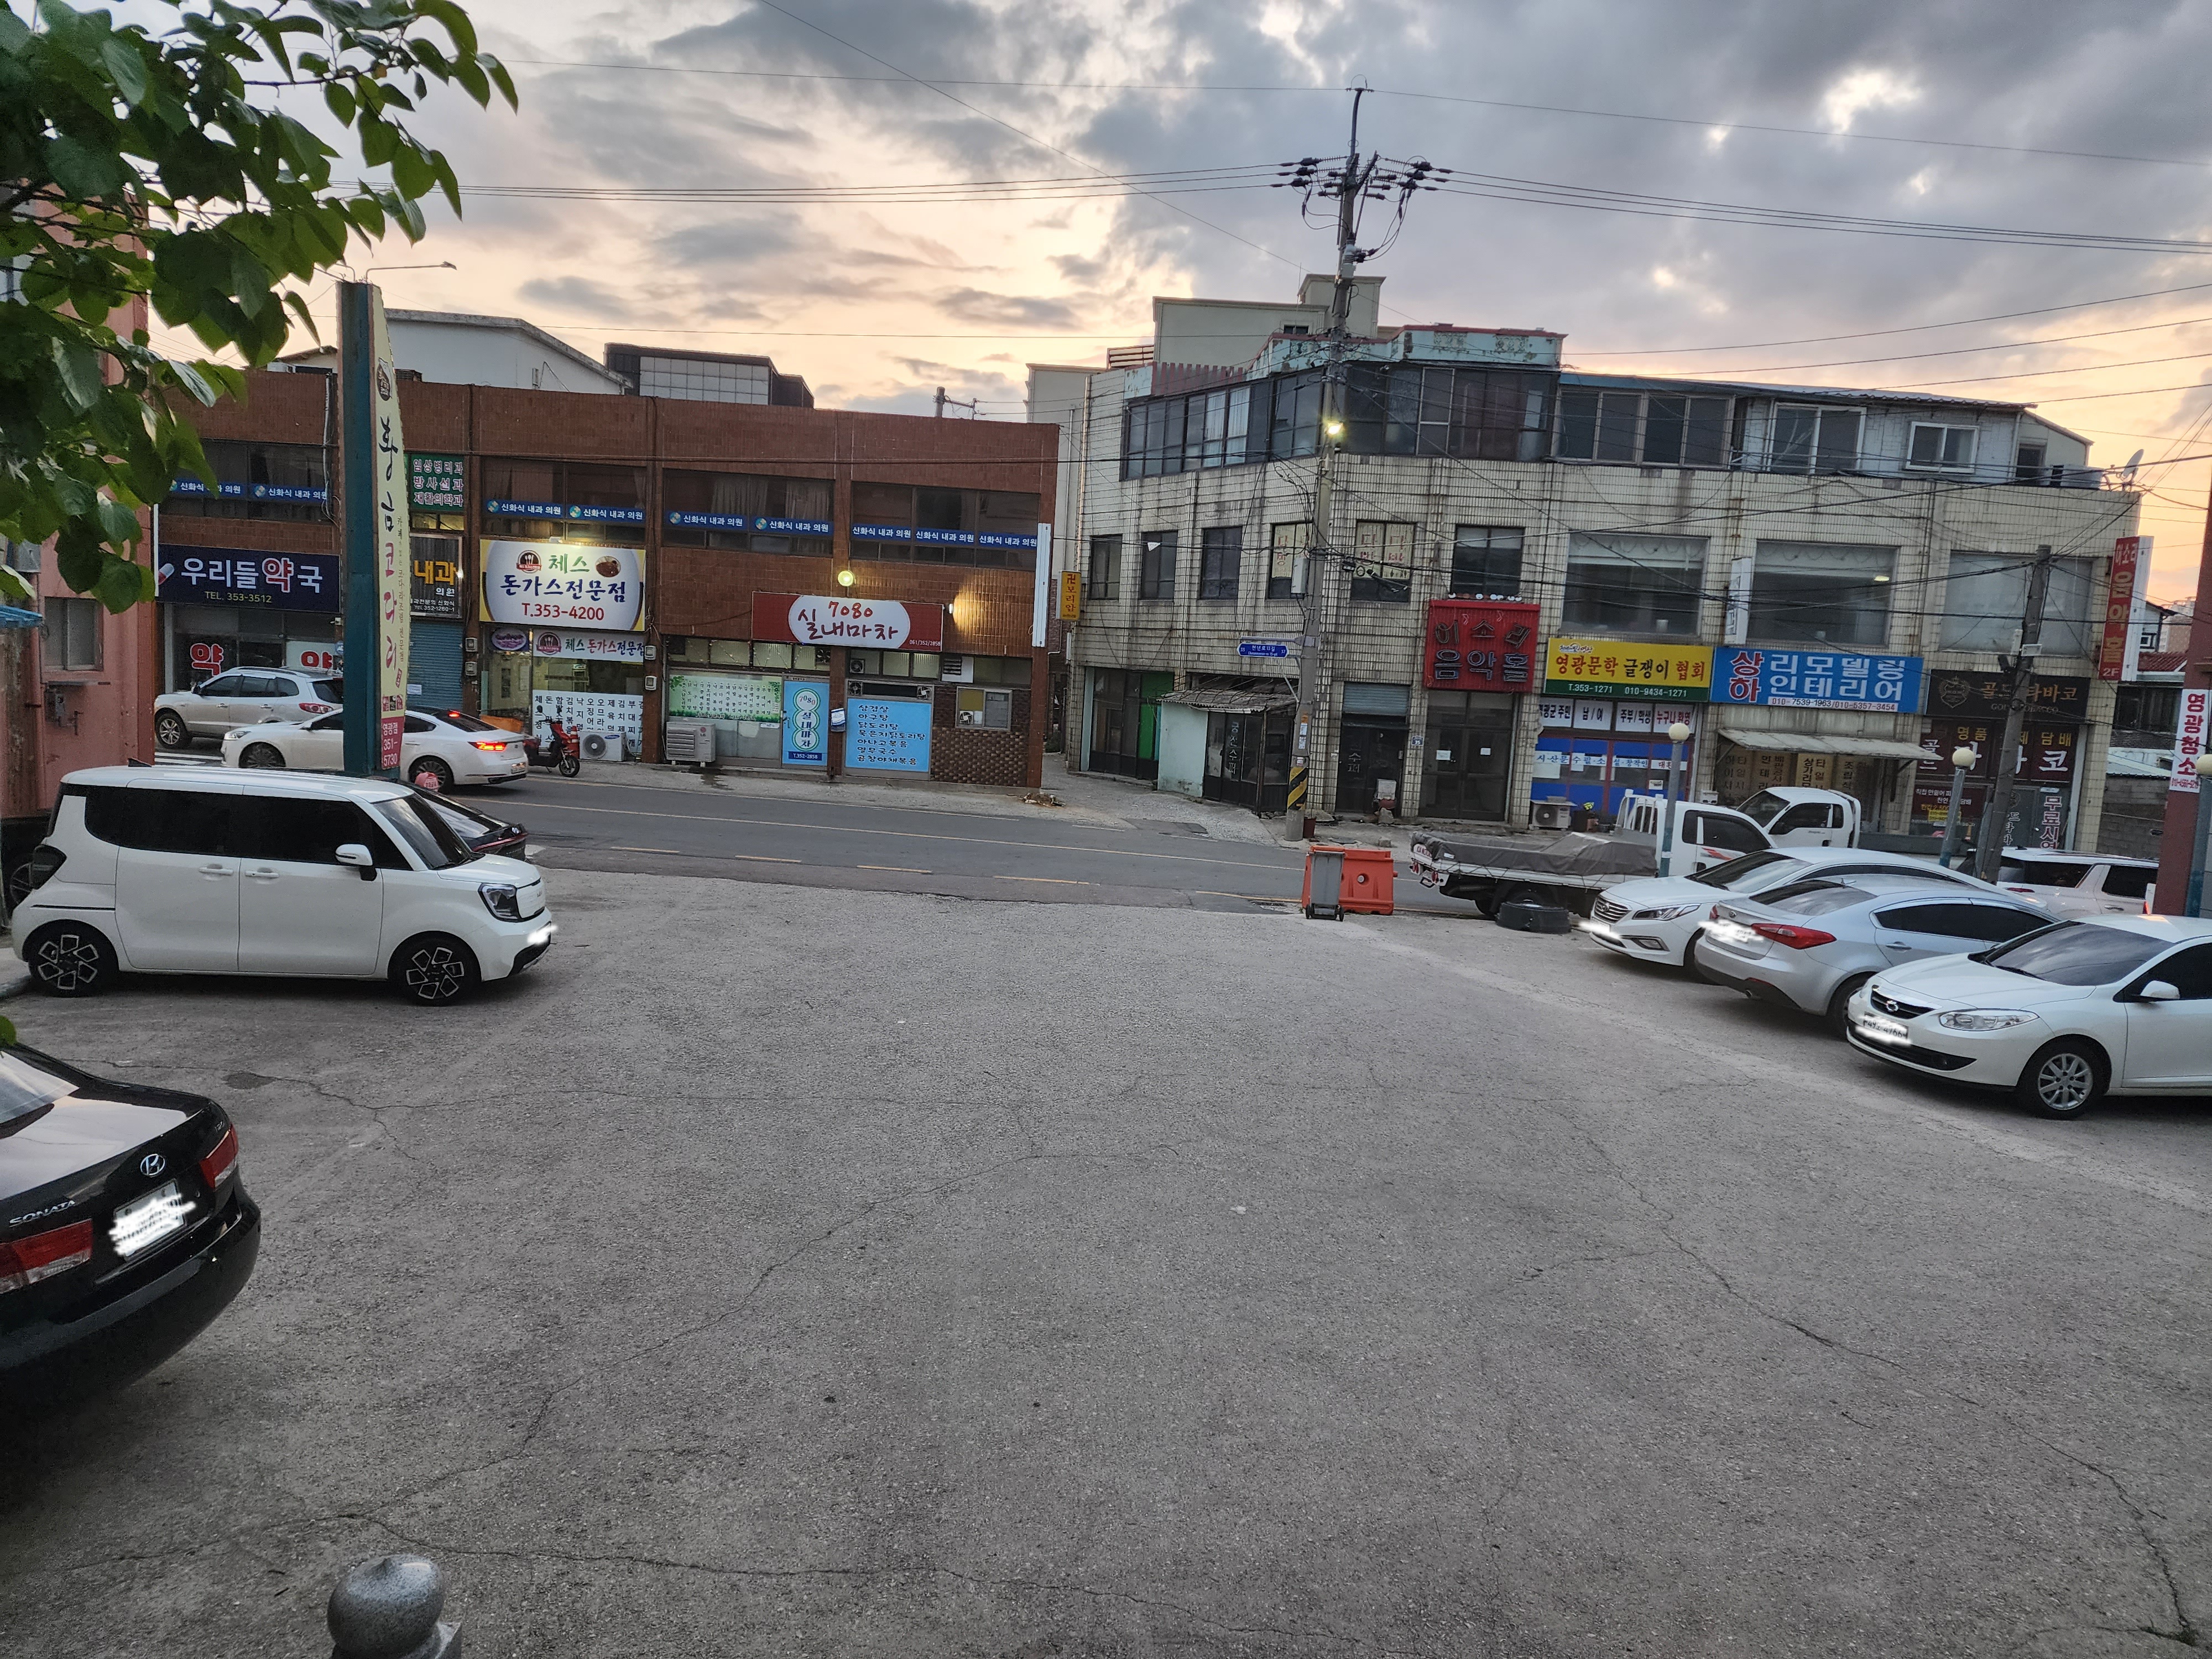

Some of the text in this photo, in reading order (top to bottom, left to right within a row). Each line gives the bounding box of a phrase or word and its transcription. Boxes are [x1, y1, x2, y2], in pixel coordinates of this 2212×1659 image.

[414, 459, 463, 475] 임상병리과
[180, 482, 204, 491] 신화식
[225, 486, 241, 494] 의원
[414, 476, 463, 492] 방사선과
[268, 488, 291, 497] 신화식
[295, 490, 310, 498] 내과
[414, 492, 463, 507] 재활의학과
[501, 503, 561, 515] 신화식 내과 의원
[583, 508, 643, 520] 신화식 내과 의원
[683, 515, 743, 526] 신화식 내과 의원
[769, 520, 828, 533] 신화식 내과 의원
[852, 526, 911, 538] 신화식 내과 의원
[916, 530, 974, 542] 신화식 내과 의원
[979, 535, 1037, 546] 신화식 내과 의원
[548, 553, 590, 574] 체스
[181, 557, 323, 593] 우리들약국
[414, 560, 458, 586] 내과
[436, 587, 455, 597] 의원
[500, 575, 626, 603] 돈가스전문점
[204, 591, 272, 603] TEL. 353-3512
[521, 602, 604, 620] T.353-4200
[828, 601, 873, 619] 7080
[2103, 571, 2133, 663] 음악홀
[797, 608, 899, 640] 실내마차
[565, 638, 585, 653] 체스
[190, 643, 224, 677] 약
[1434, 649, 1530, 682] 음악홀
[1770, 654, 1906, 681] 리모델링
[1556, 654, 1705, 682] 영광문학 글쟁이 협회
[2103, 667, 2120, 676] 2F
[1568, 683, 1687, 697] T.353-1271 010-9434-1271
[1770, 675, 1903, 701] 인테리어
[799, 695, 816, 705] 7080
[597, 699, 605, 730] 오므라
[858, 705, 889, 713] 삼겹살
[1558, 705, 1572, 719] 주민
[628, 701, 636, 747] 부대찌개
[800, 712, 812, 747] 실내마차
[858, 722, 899, 730] 닭도리탕
[1957, 726, 1987, 742] 명품
[2041, 732, 2072, 747] 담배
[2177, 693, 2205, 776] 영광청소
[857, 739, 907, 748] 아나고볶음
[383, 753, 398, 767] 5730
[857, 755, 917, 765] 곱창야채볶음
[9, 1199, 76, 1228] SONATA
